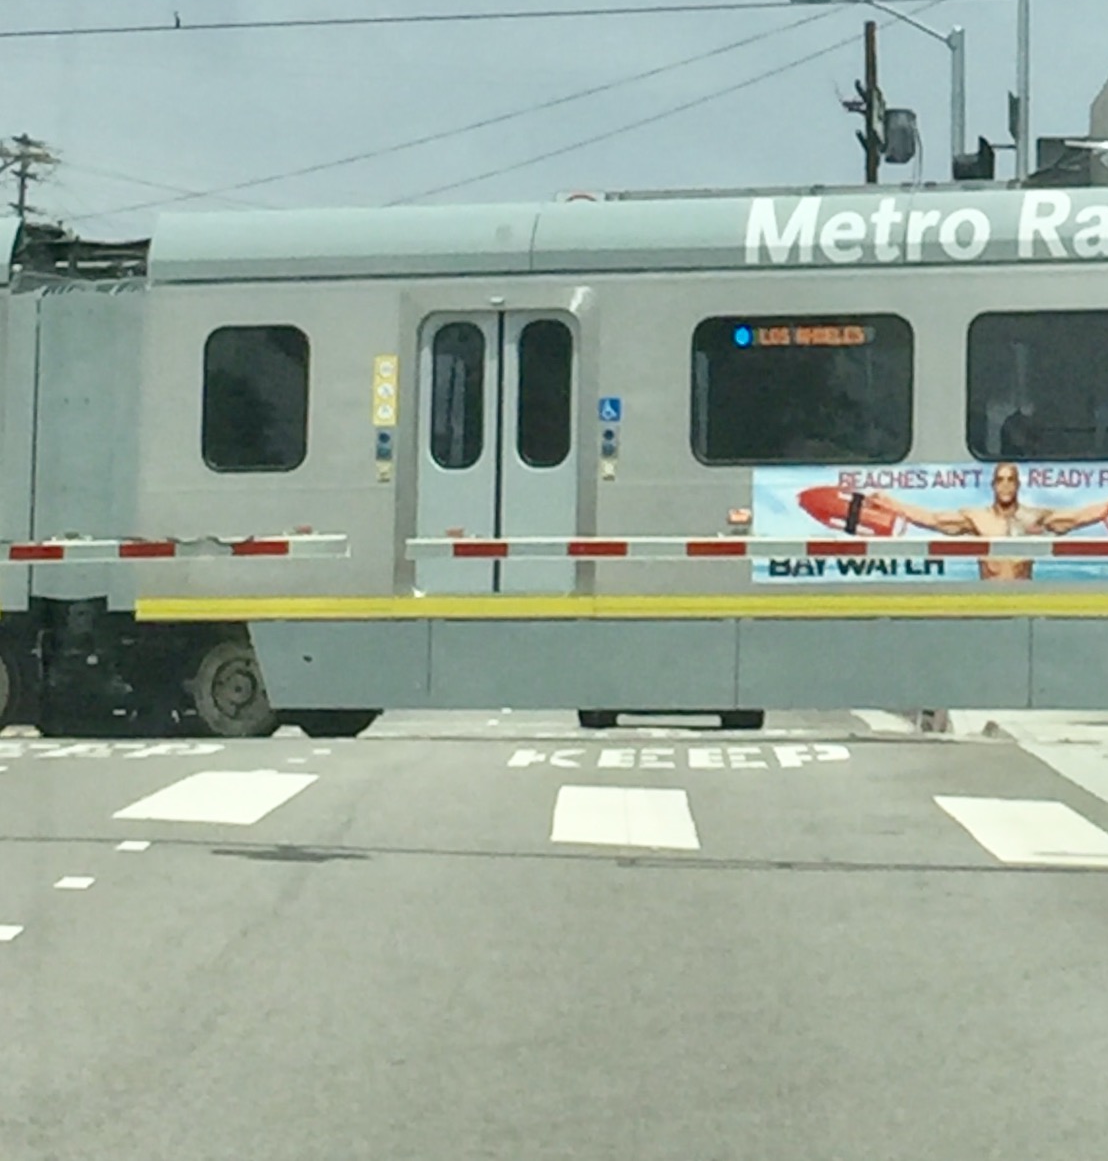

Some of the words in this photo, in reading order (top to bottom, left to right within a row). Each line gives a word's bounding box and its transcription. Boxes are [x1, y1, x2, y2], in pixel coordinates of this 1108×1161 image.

[745, 196, 991, 264] Metro
[759, 326, 791, 346] LOS
[838, 469, 929, 489] BEACHES
[932, 468, 983, 488] AIN'T
[1028, 468, 1093, 488] READY
[507, 744, 850, 768] KEEP
